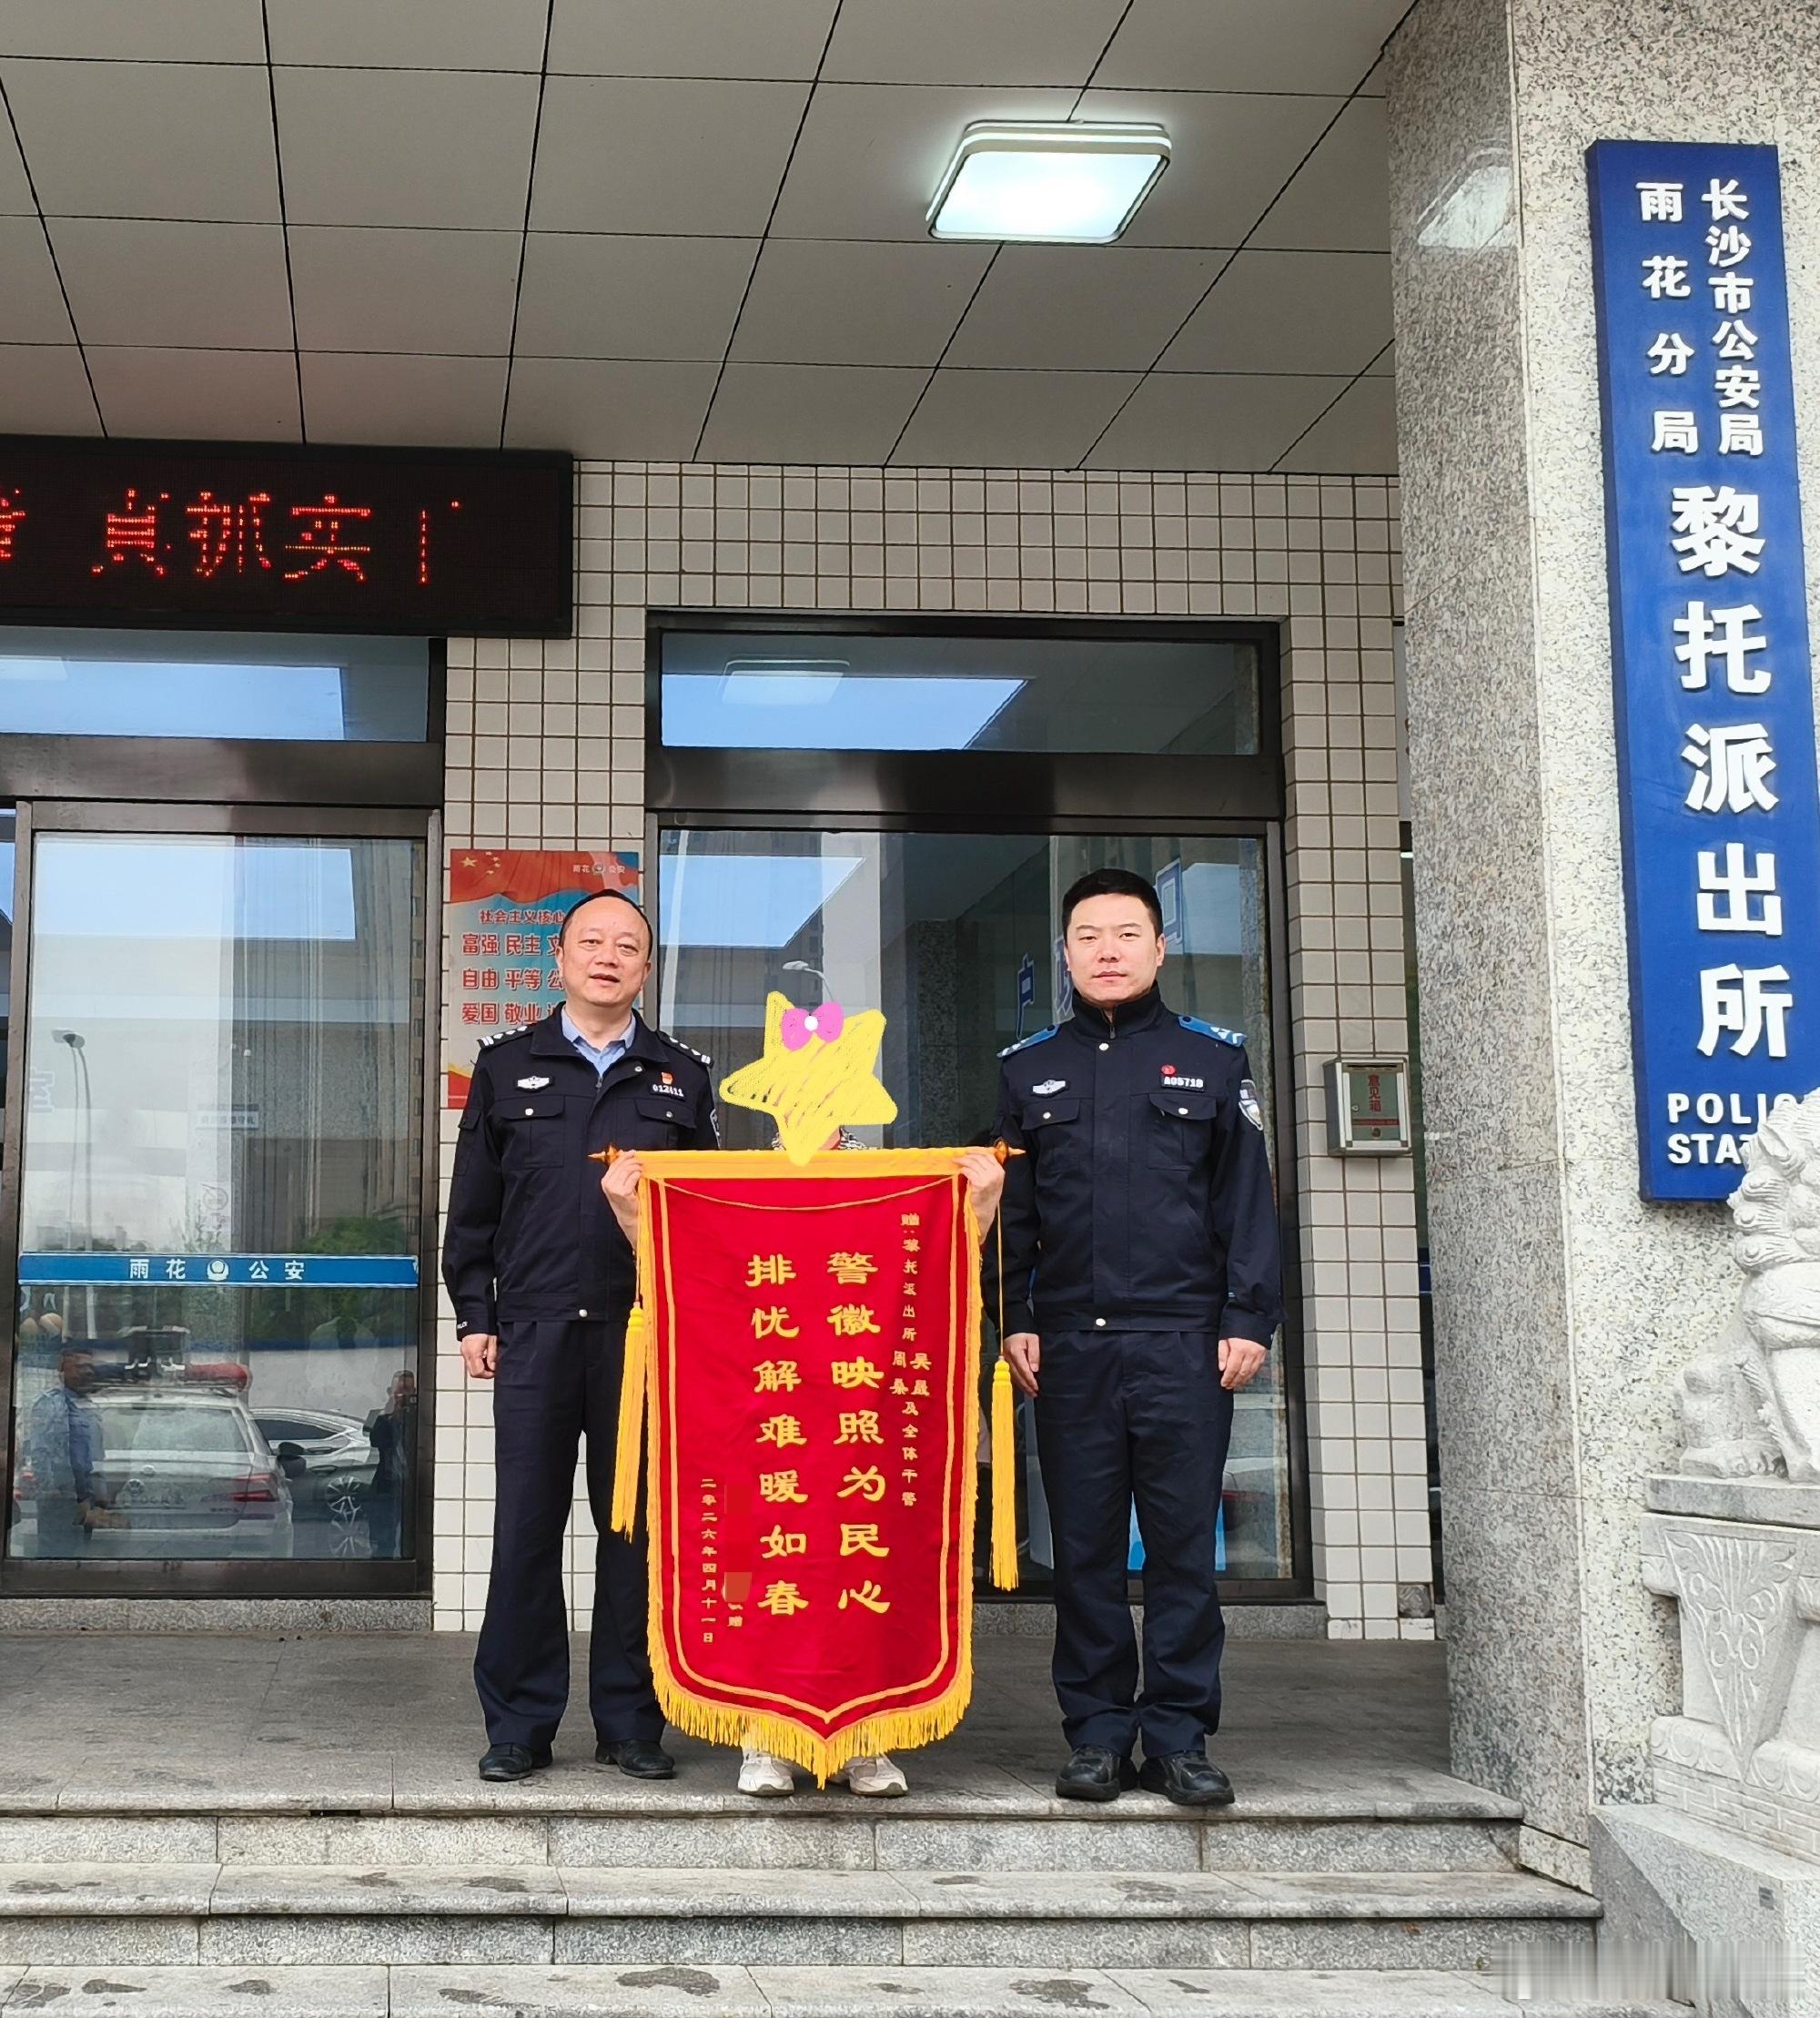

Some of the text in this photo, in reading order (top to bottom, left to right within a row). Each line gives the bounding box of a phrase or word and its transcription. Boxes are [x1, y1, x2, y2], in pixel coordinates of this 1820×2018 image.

[1635, 182, 1699, 454] 雨花分局
[1701, 178, 1764, 457] 长沙市公安局
[1670, 484, 1794, 1060] 黎托派出所
[462, 933, 500, 956] 富强
[505, 933, 542, 957] 民主
[462, 968, 500, 990] 自由
[504, 968, 542, 991] 平等
[479, 909, 565, 926] 社会主义核心
[461, 1002, 500, 1025] 爱国
[504, 1002, 542, 1025] 敬业
[129, 1258, 305, 1282] 雨花 公安
[745, 1252, 809, 1617] 排忧解难暖如春
[827, 1252, 891, 1615] 警徽映照为民心
[700, 1478, 718, 1644] 二零二六年四月十一日
